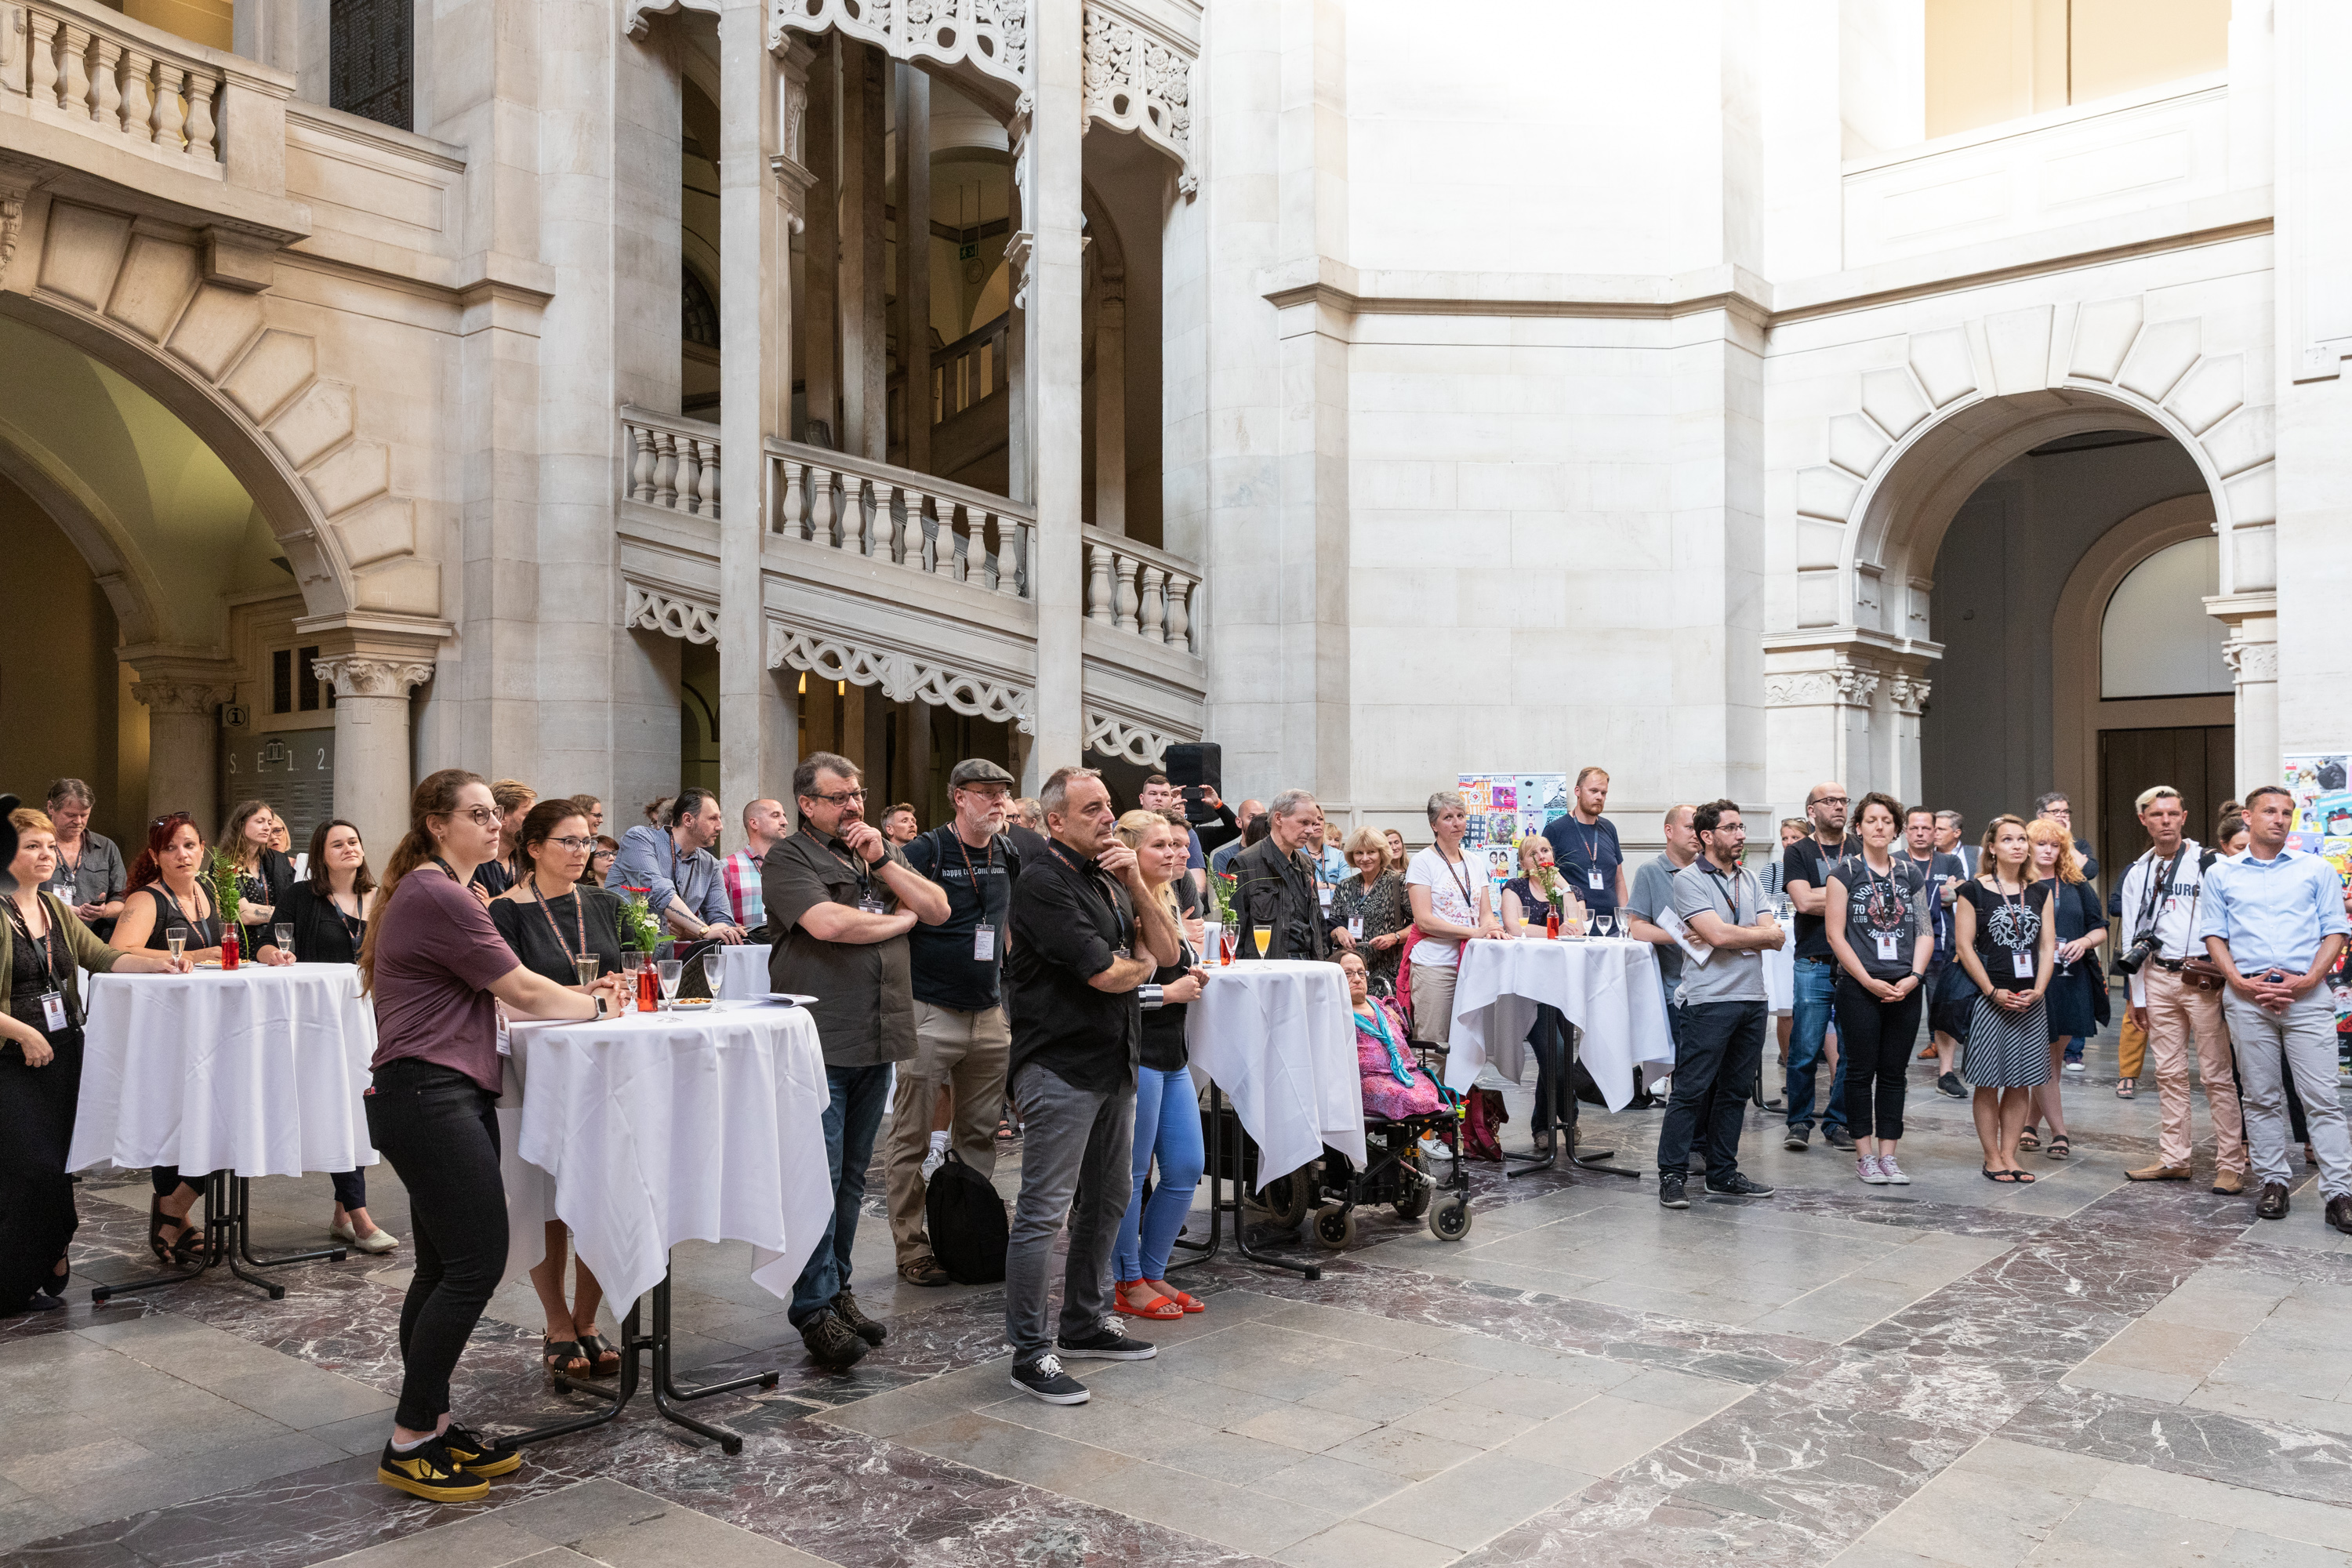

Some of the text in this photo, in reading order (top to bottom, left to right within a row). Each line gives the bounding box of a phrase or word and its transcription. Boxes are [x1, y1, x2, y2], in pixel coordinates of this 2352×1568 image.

[230, 748, 325, 774] S E 1 2
[1476, 779, 1491, 790] MY
[942, 868, 962, 878] happy
[1853, 904, 1865, 914] 70
[545, 911, 555, 925] Global
[552, 924, 561, 938] Street
[558, 937, 567, 950] Paper
[565, 949, 576, 966] Summit
